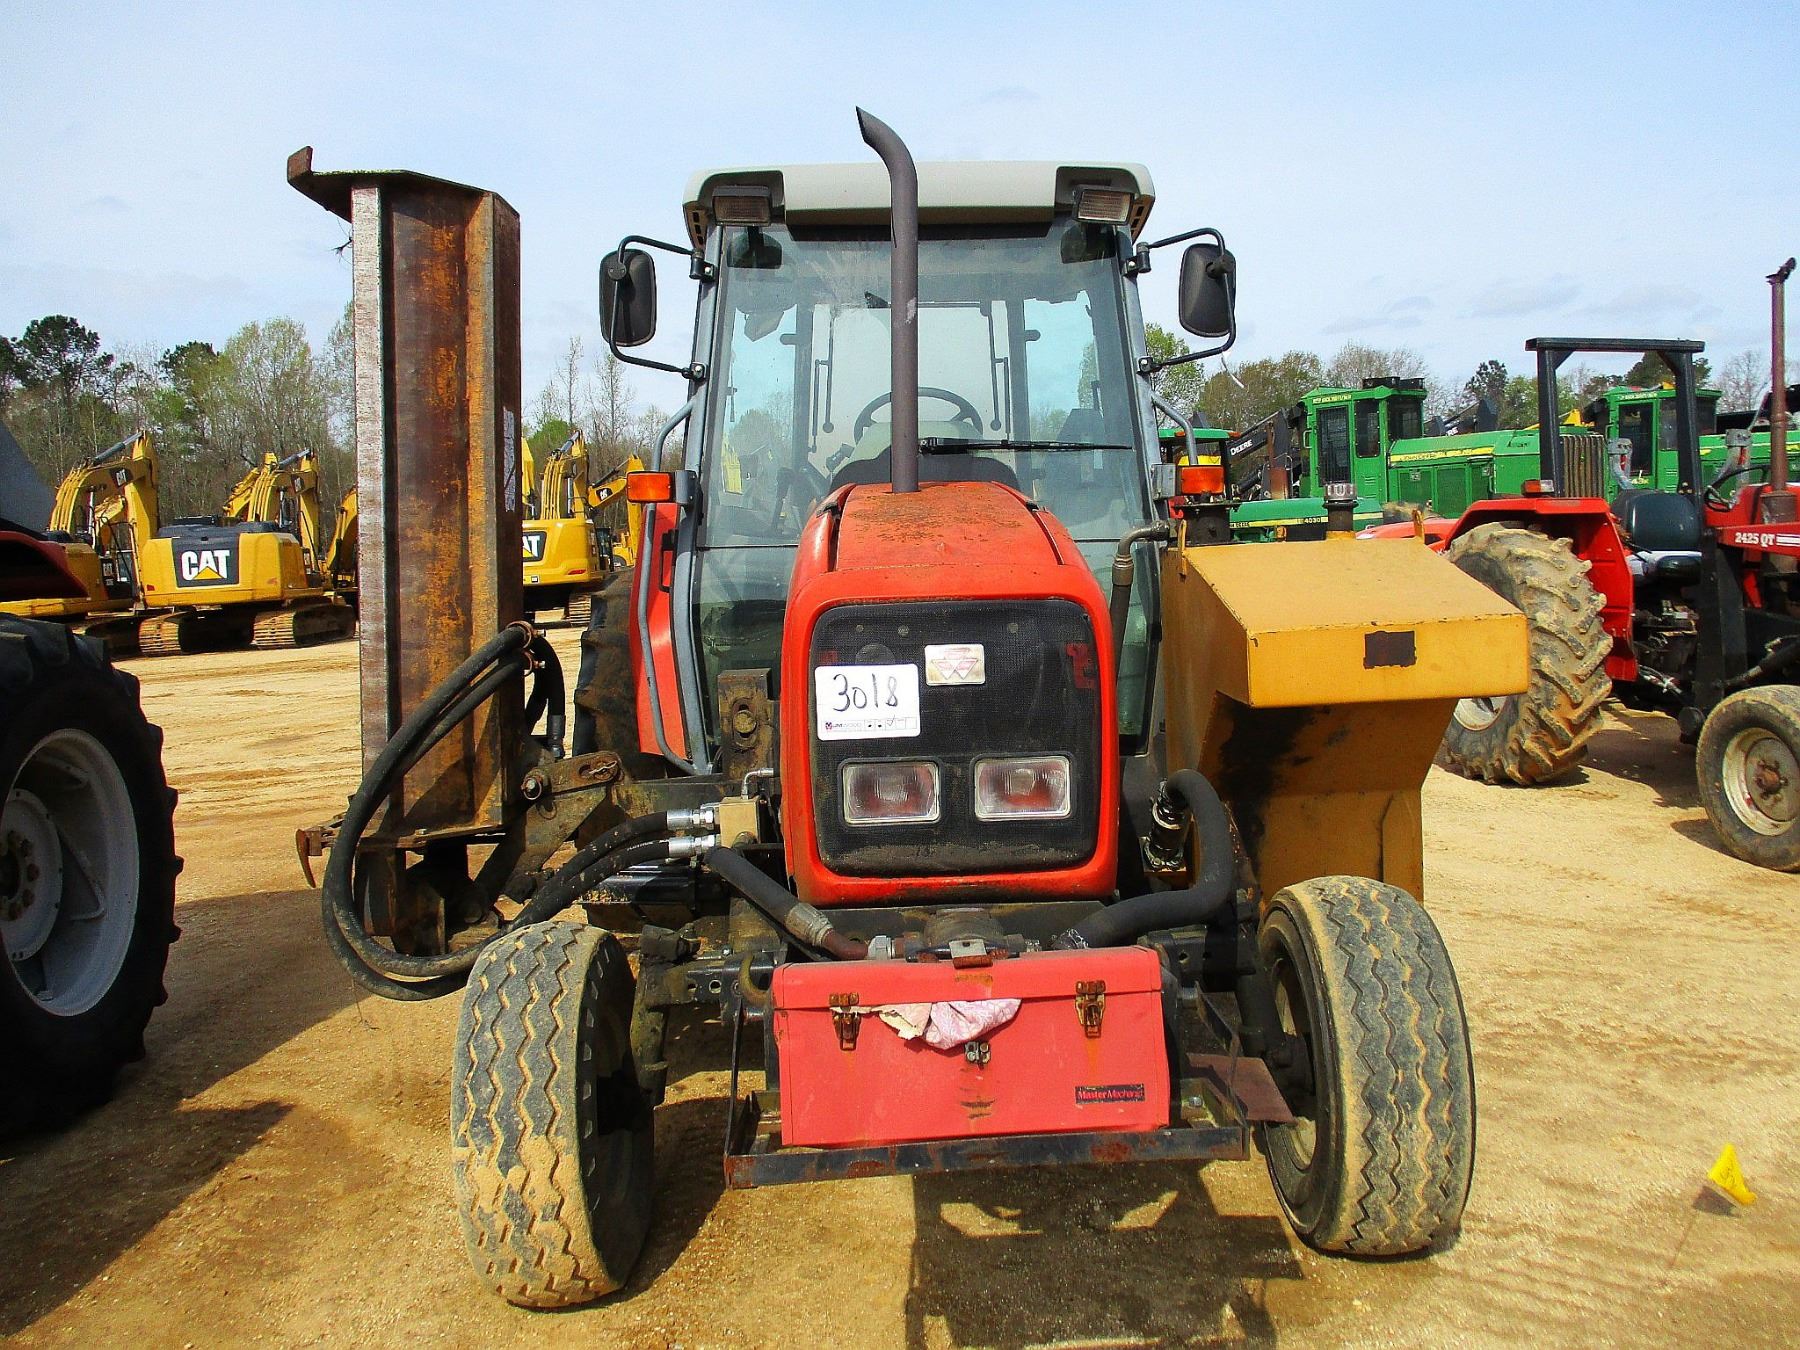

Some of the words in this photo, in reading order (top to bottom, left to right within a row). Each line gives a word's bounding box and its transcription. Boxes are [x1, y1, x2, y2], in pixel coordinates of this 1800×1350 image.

[1230, 439, 1253, 456] DEERE
[522, 535, 541, 558] AT
[1735, 532, 1760, 544] 2425
[1761, 533, 1775, 547] QT
[181, 549, 230, 581] CAT
[833, 673, 899, 712] 3018
